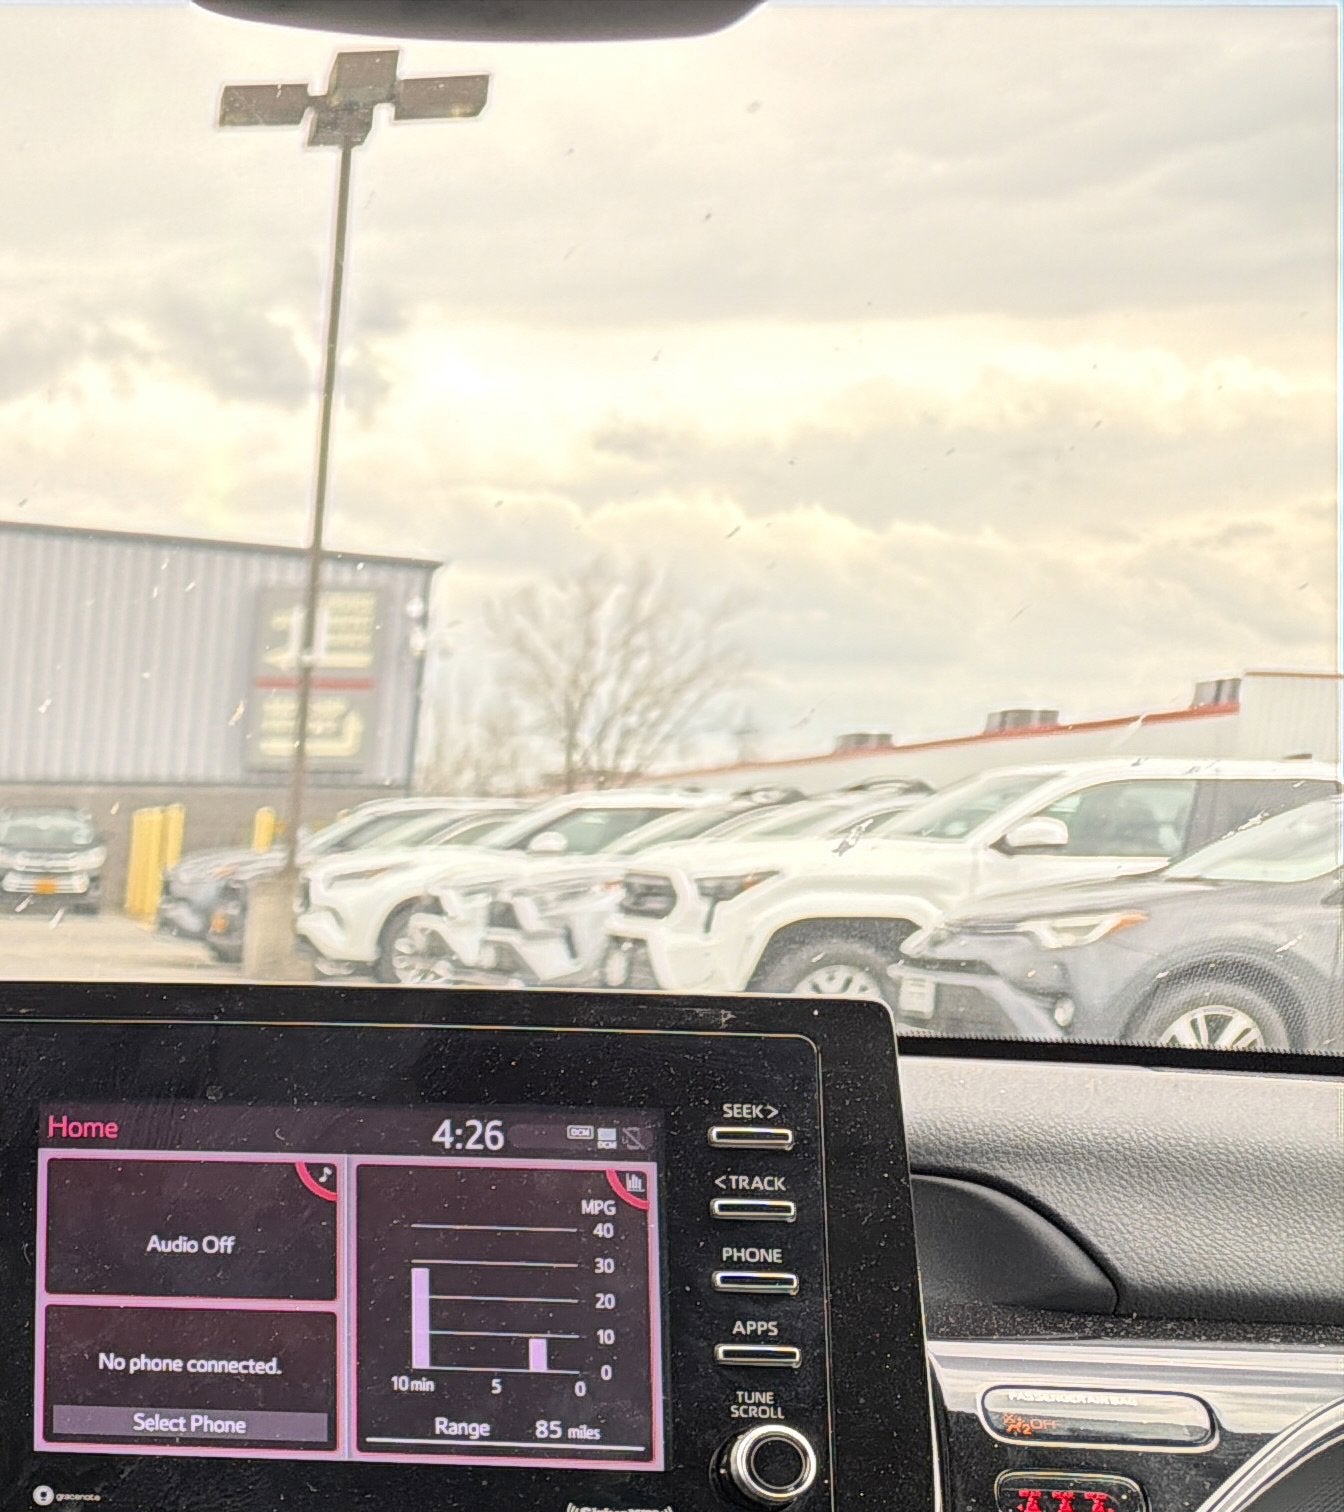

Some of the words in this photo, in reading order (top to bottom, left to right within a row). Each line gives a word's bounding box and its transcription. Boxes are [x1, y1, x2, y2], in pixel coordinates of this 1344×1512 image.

[48, 1115, 118, 1138] Home
[432, 1118, 505, 1150] 4:26
[581, 1200, 616, 1215] MPG
[593, 1222, 614, 1238] 40
[146, 1235, 199, 1253] Audio
[202, 1236, 236, 1254] Off
[722, 1247, 782, 1263] PHONE
[594, 1257, 615, 1274] 30
[595, 1293, 616, 1309] 20
[732, 1320, 778, 1336] APPS
[597, 1329, 615, 1345] 10
[99, 1352, 126, 1370] No
[129, 1354, 183, 1374] phone
[187, 1357, 282, 1375] connected.
[600, 1364, 612, 1380] 0
[392, 1375, 409, 1391] 10
[411, 1376, 435, 1391] min
[491, 1378, 502, 1394] 5
[574, 1381, 586, 1397] 0
[736, 1391, 775, 1404] TUNE
[730, 1404, 785, 1419] SCROLL
[132, 1412, 186, 1432] Select
[190, 1415, 246, 1434] Phone
[435, 1416, 490, 1439] Range
[535, 1420, 562, 1439] 85
[567, 1424, 600, 1440] miles
